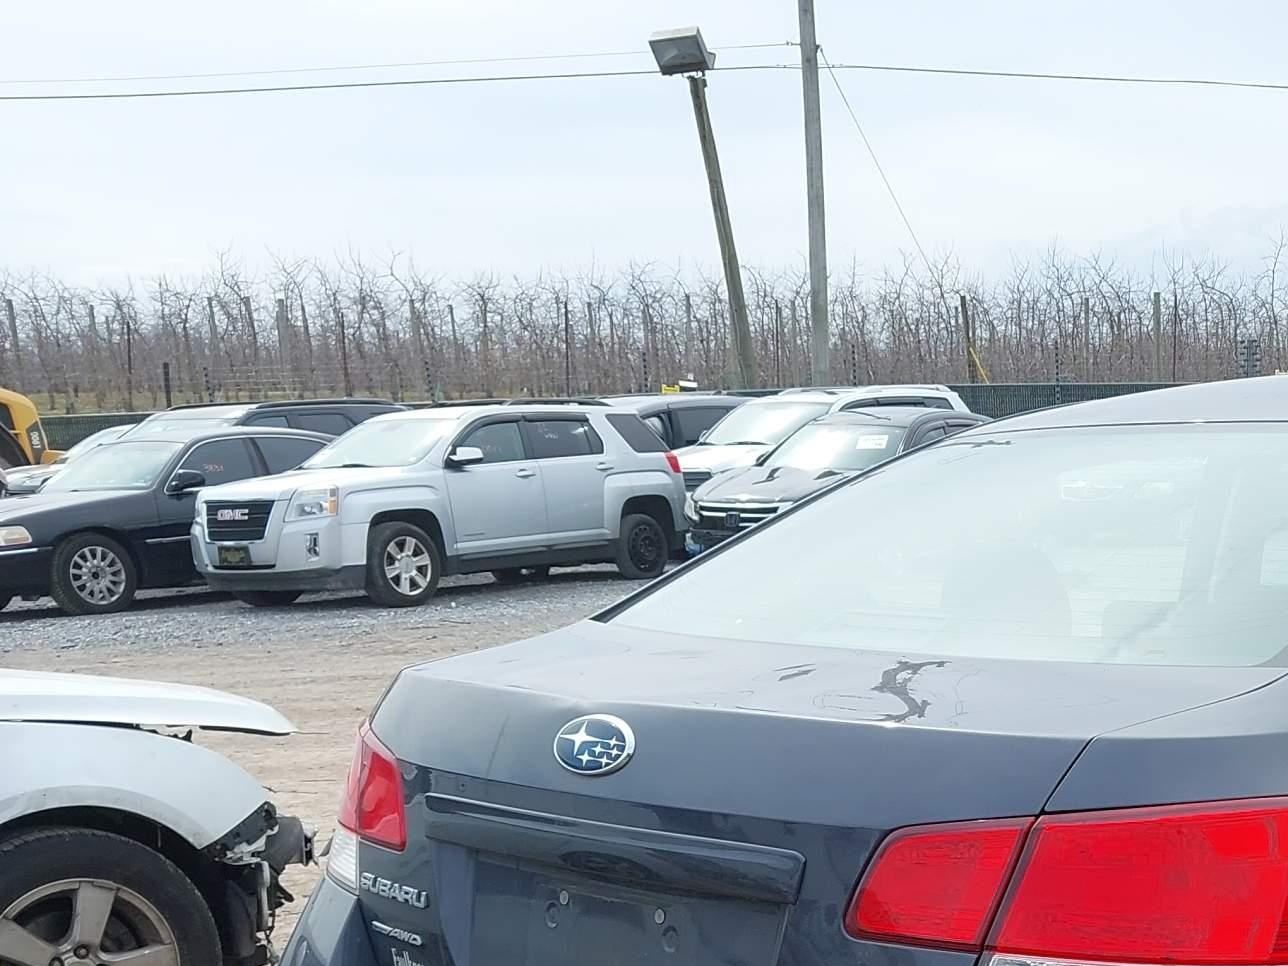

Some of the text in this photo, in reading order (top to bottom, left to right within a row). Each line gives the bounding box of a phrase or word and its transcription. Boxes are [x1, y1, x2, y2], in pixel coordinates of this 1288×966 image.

[217, 508, 249, 521] GMC
[360, 871, 428, 909] SUBARU
[389, 928, 423, 947] AWD
